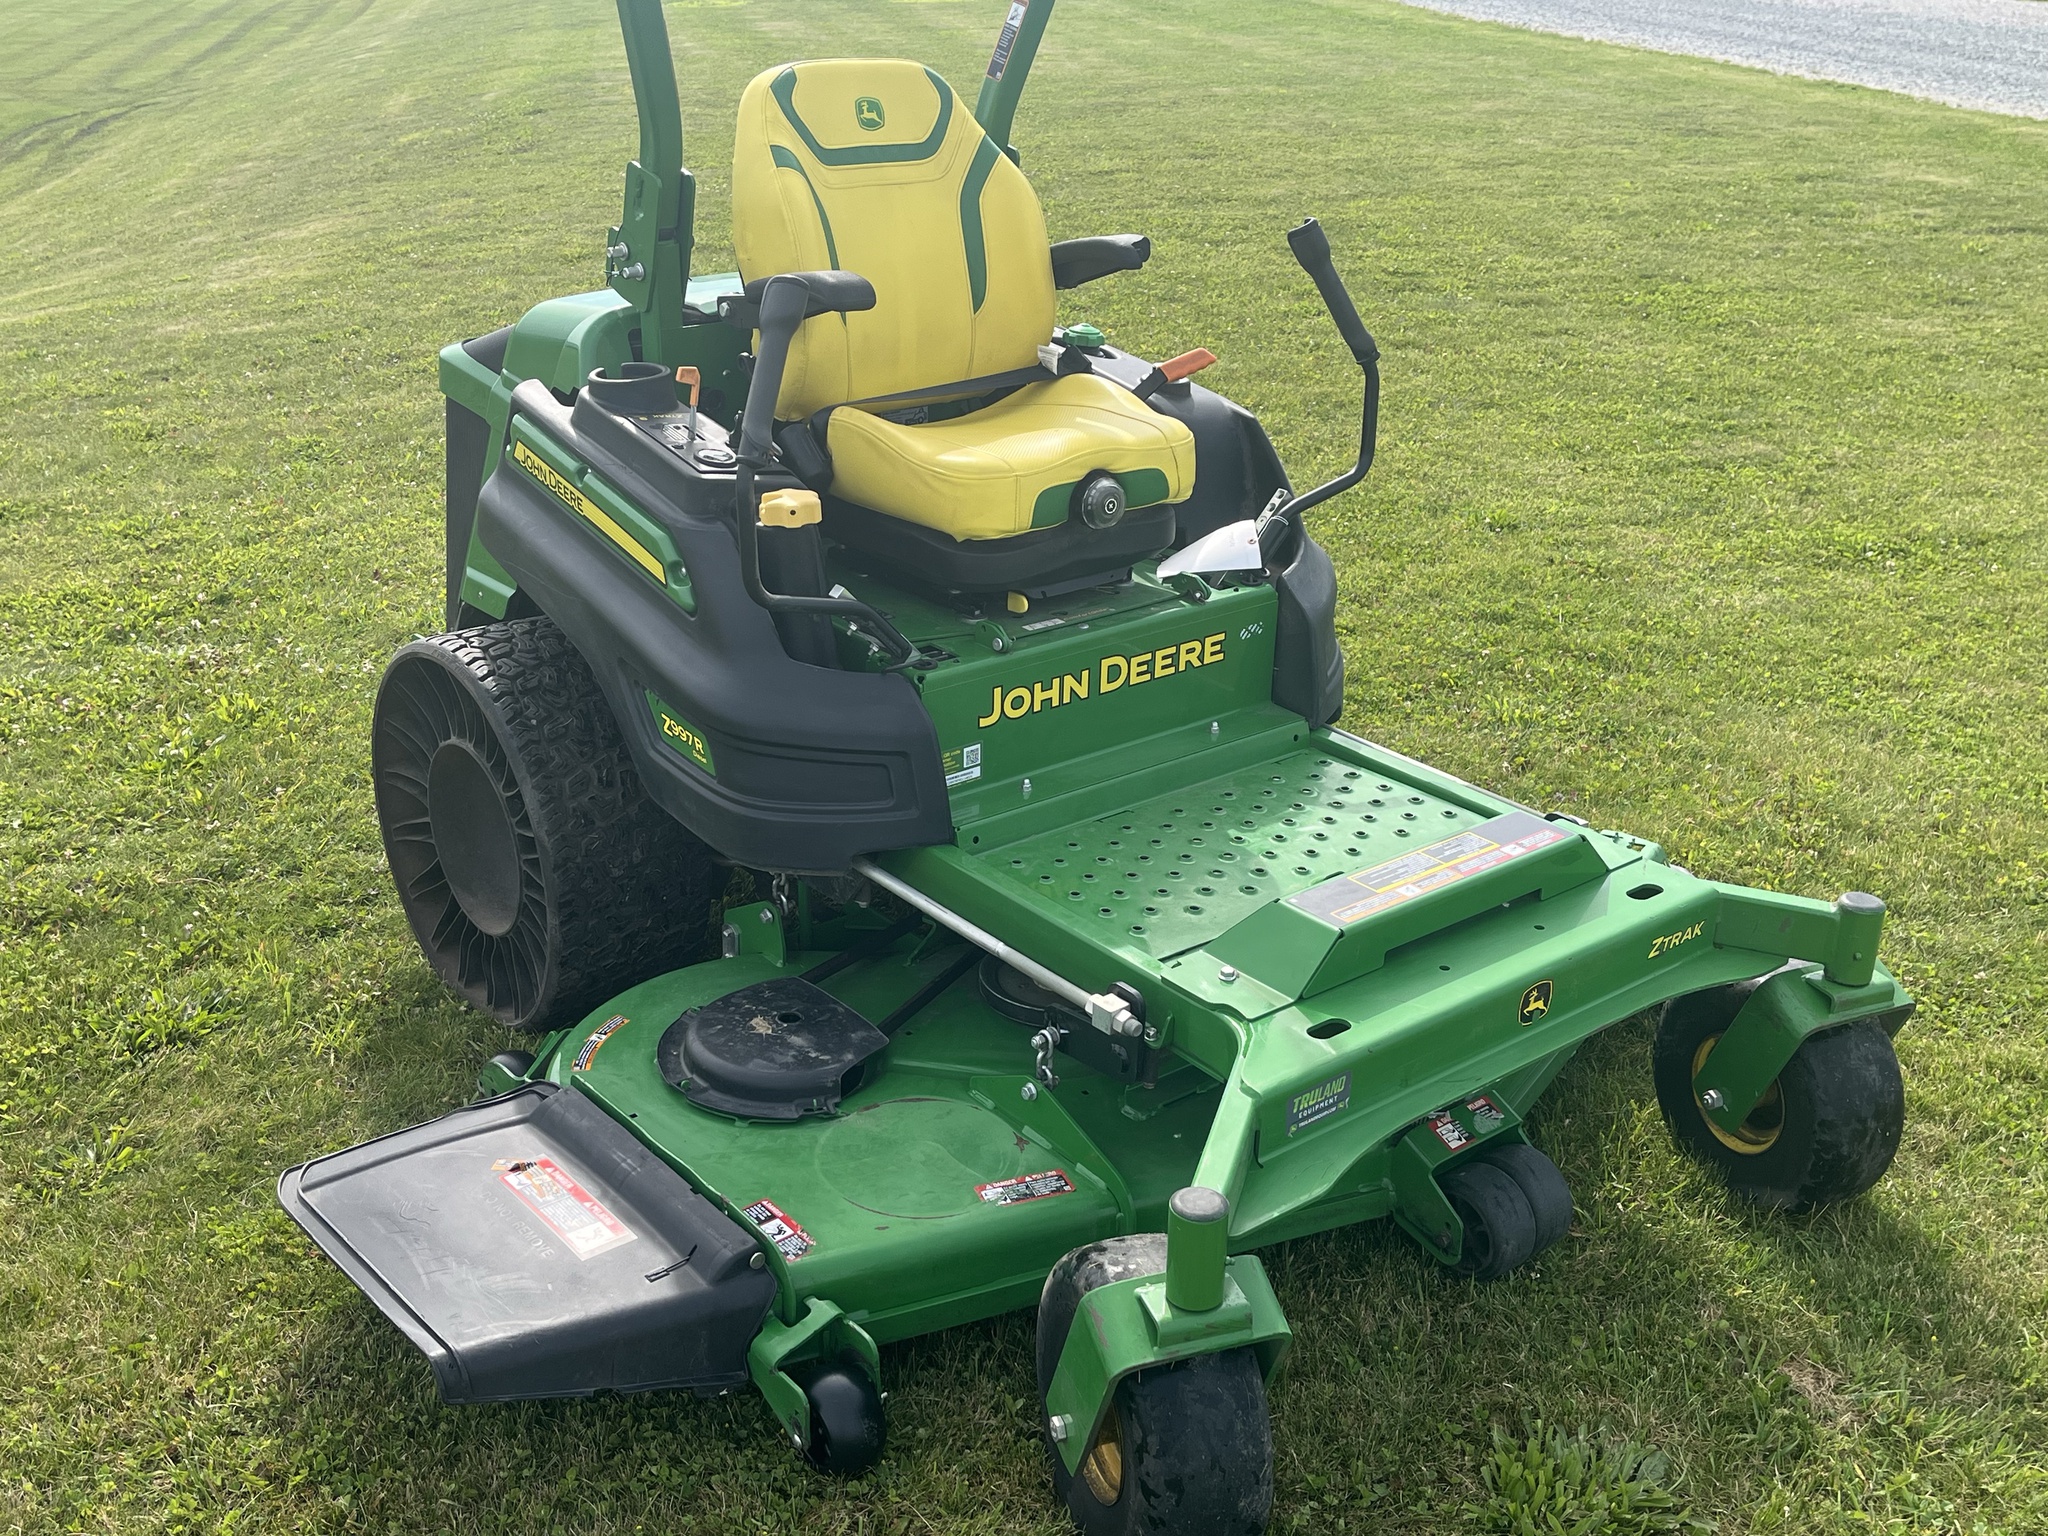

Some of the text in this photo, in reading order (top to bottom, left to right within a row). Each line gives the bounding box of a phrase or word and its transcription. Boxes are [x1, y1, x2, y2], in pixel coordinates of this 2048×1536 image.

[519, 448, 584, 514] JOHN DEERE
[978, 631, 1227, 728] JOHN DEERE
[661, 712, 705, 755] Z997R
[1647, 920, 1705, 959] ZTRAK
[1293, 1075, 1347, 1114] TRULAND
[1298, 1095, 1338, 1119] EQUIPMENT
[511, 1218, 556, 1259] REMOVE
